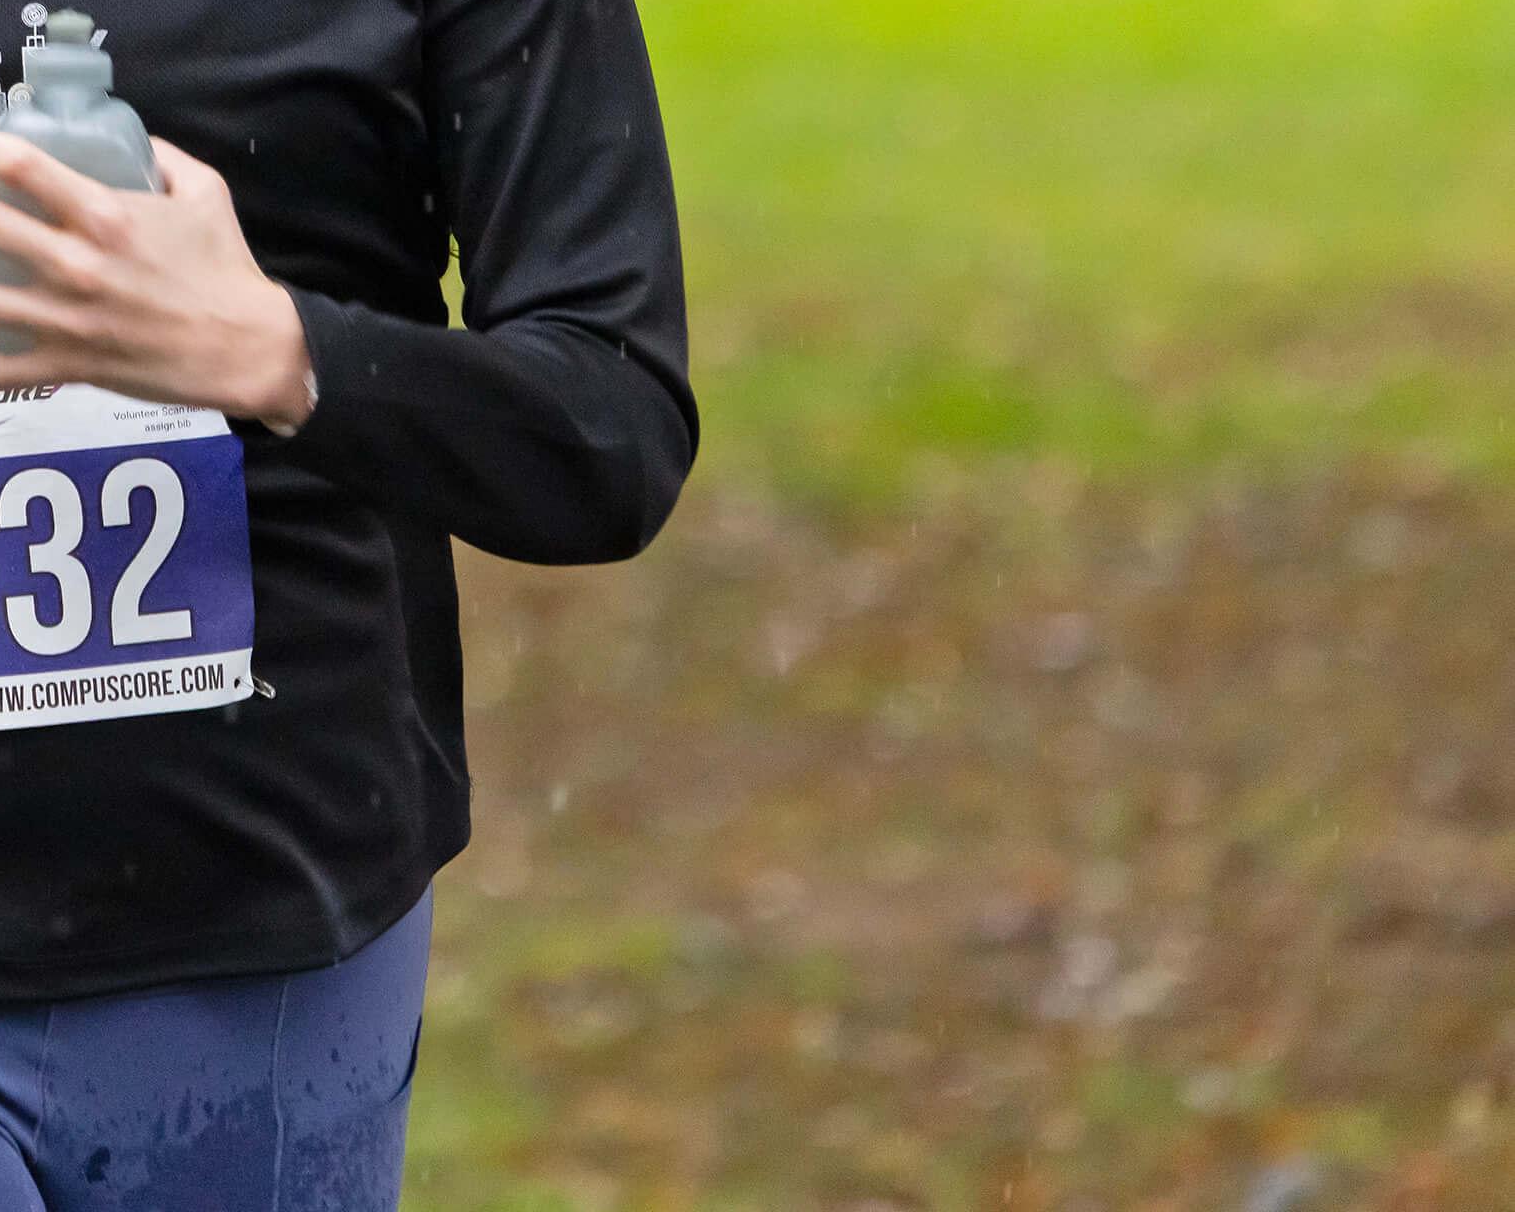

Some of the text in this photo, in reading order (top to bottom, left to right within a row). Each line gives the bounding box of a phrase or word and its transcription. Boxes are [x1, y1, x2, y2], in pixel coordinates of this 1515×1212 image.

[113, 408, 159, 420] Volunteer
[161, 404, 185, 416] Scan
[145, 419, 191, 432] assign bib
